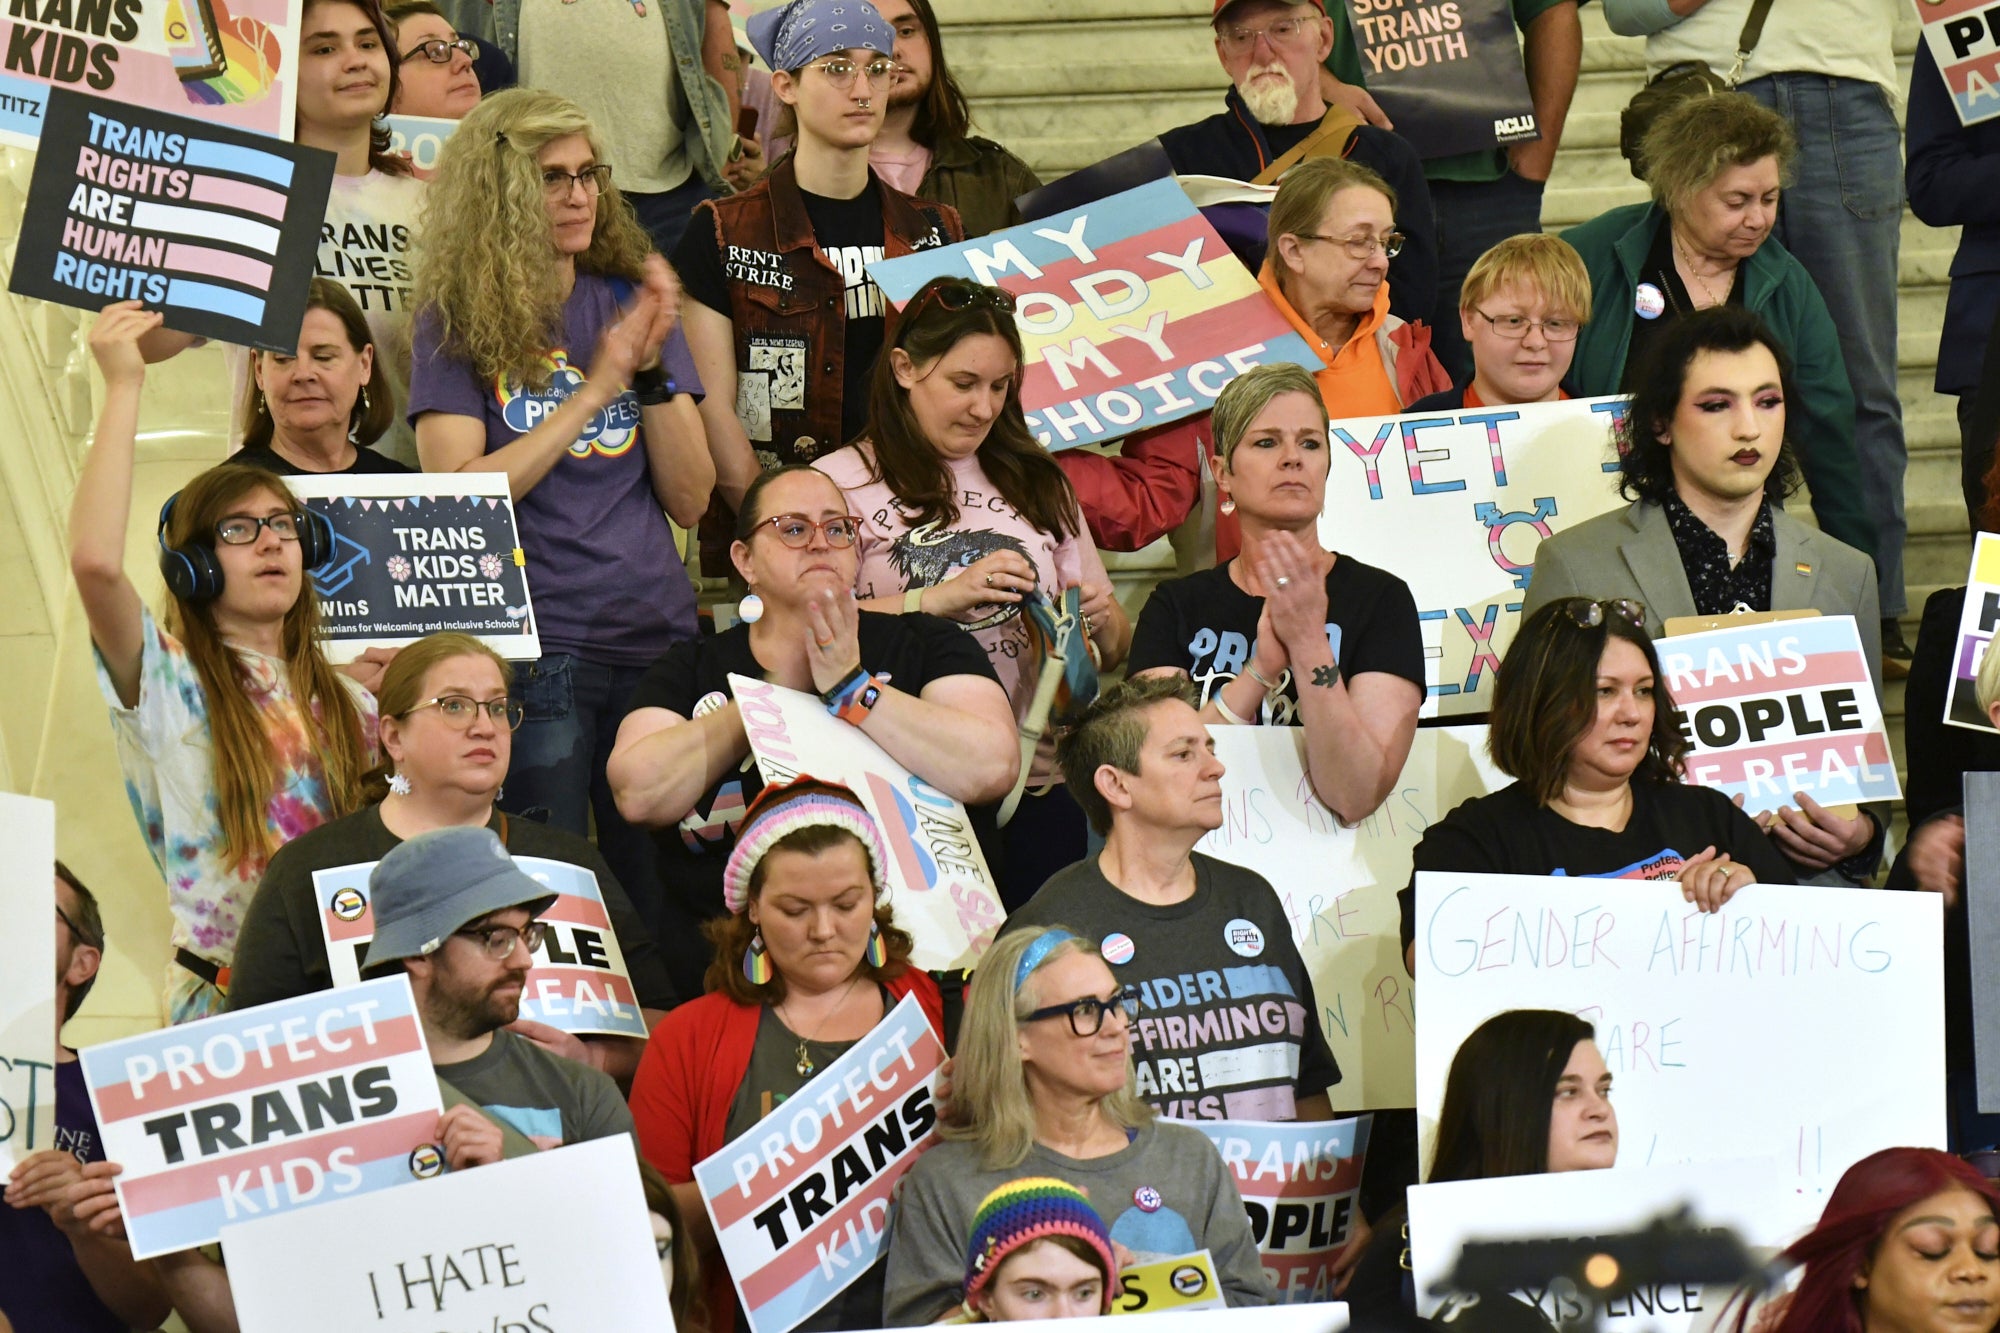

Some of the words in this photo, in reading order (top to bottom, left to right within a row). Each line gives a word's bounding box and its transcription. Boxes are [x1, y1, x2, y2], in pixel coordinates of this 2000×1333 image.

[1357, 3, 1462, 45] TRANS
[5, 23, 119, 91] KIDS
[1364, 31, 1468, 73] YOUTH
[88, 112, 184, 163] TRANS
[1494, 115, 1535, 135] ACLU
[76, 147, 190, 199] RIGHTS
[68, 183, 132, 226] ARE
[61, 217, 165, 268] HUMAN
[728, 245, 782, 268] RENT
[962, 214, 1099, 287] MY
[53, 251, 167, 303] RIGHTS
[726, 263, 794, 291] STRIKE
[1040, 311, 1175, 391] MY
[1332, 411, 1520, 500] YET
[393, 527, 486, 551] TRANS
[413, 555, 477, 579] KIDS
[394, 583, 507, 608] MATTER
[359, 623, 372, 633] for
[374, 622, 424, 632] Welcoming
[425, 621, 442, 630] and
[443, 620, 483, 629] Inclusive
[484, 619, 519, 629] Schools
[1665, 636, 1807, 691] RANS
[735, 684, 798, 762] YOU
[1744, 746, 1885, 798] REAL
[915, 804, 984, 883] ARE
[1282, 889, 1368, 946] ARE
[1427, 886, 1620, 977] GENDER
[1648, 909, 1892, 978] AFFIRMING
[125, 999, 379, 1100] PROTECT
[1135, 1057, 1199, 1097] ARE
[144, 1066, 398, 1164] TRANS
[732, 1026, 916, 1199] PROTECT
[217, 1146, 363, 1219] KIDS
[753, 1086, 937, 1251] TRANS
[367, 1271, 385, 1320] I
[395, 1243, 525, 1312] HATE
